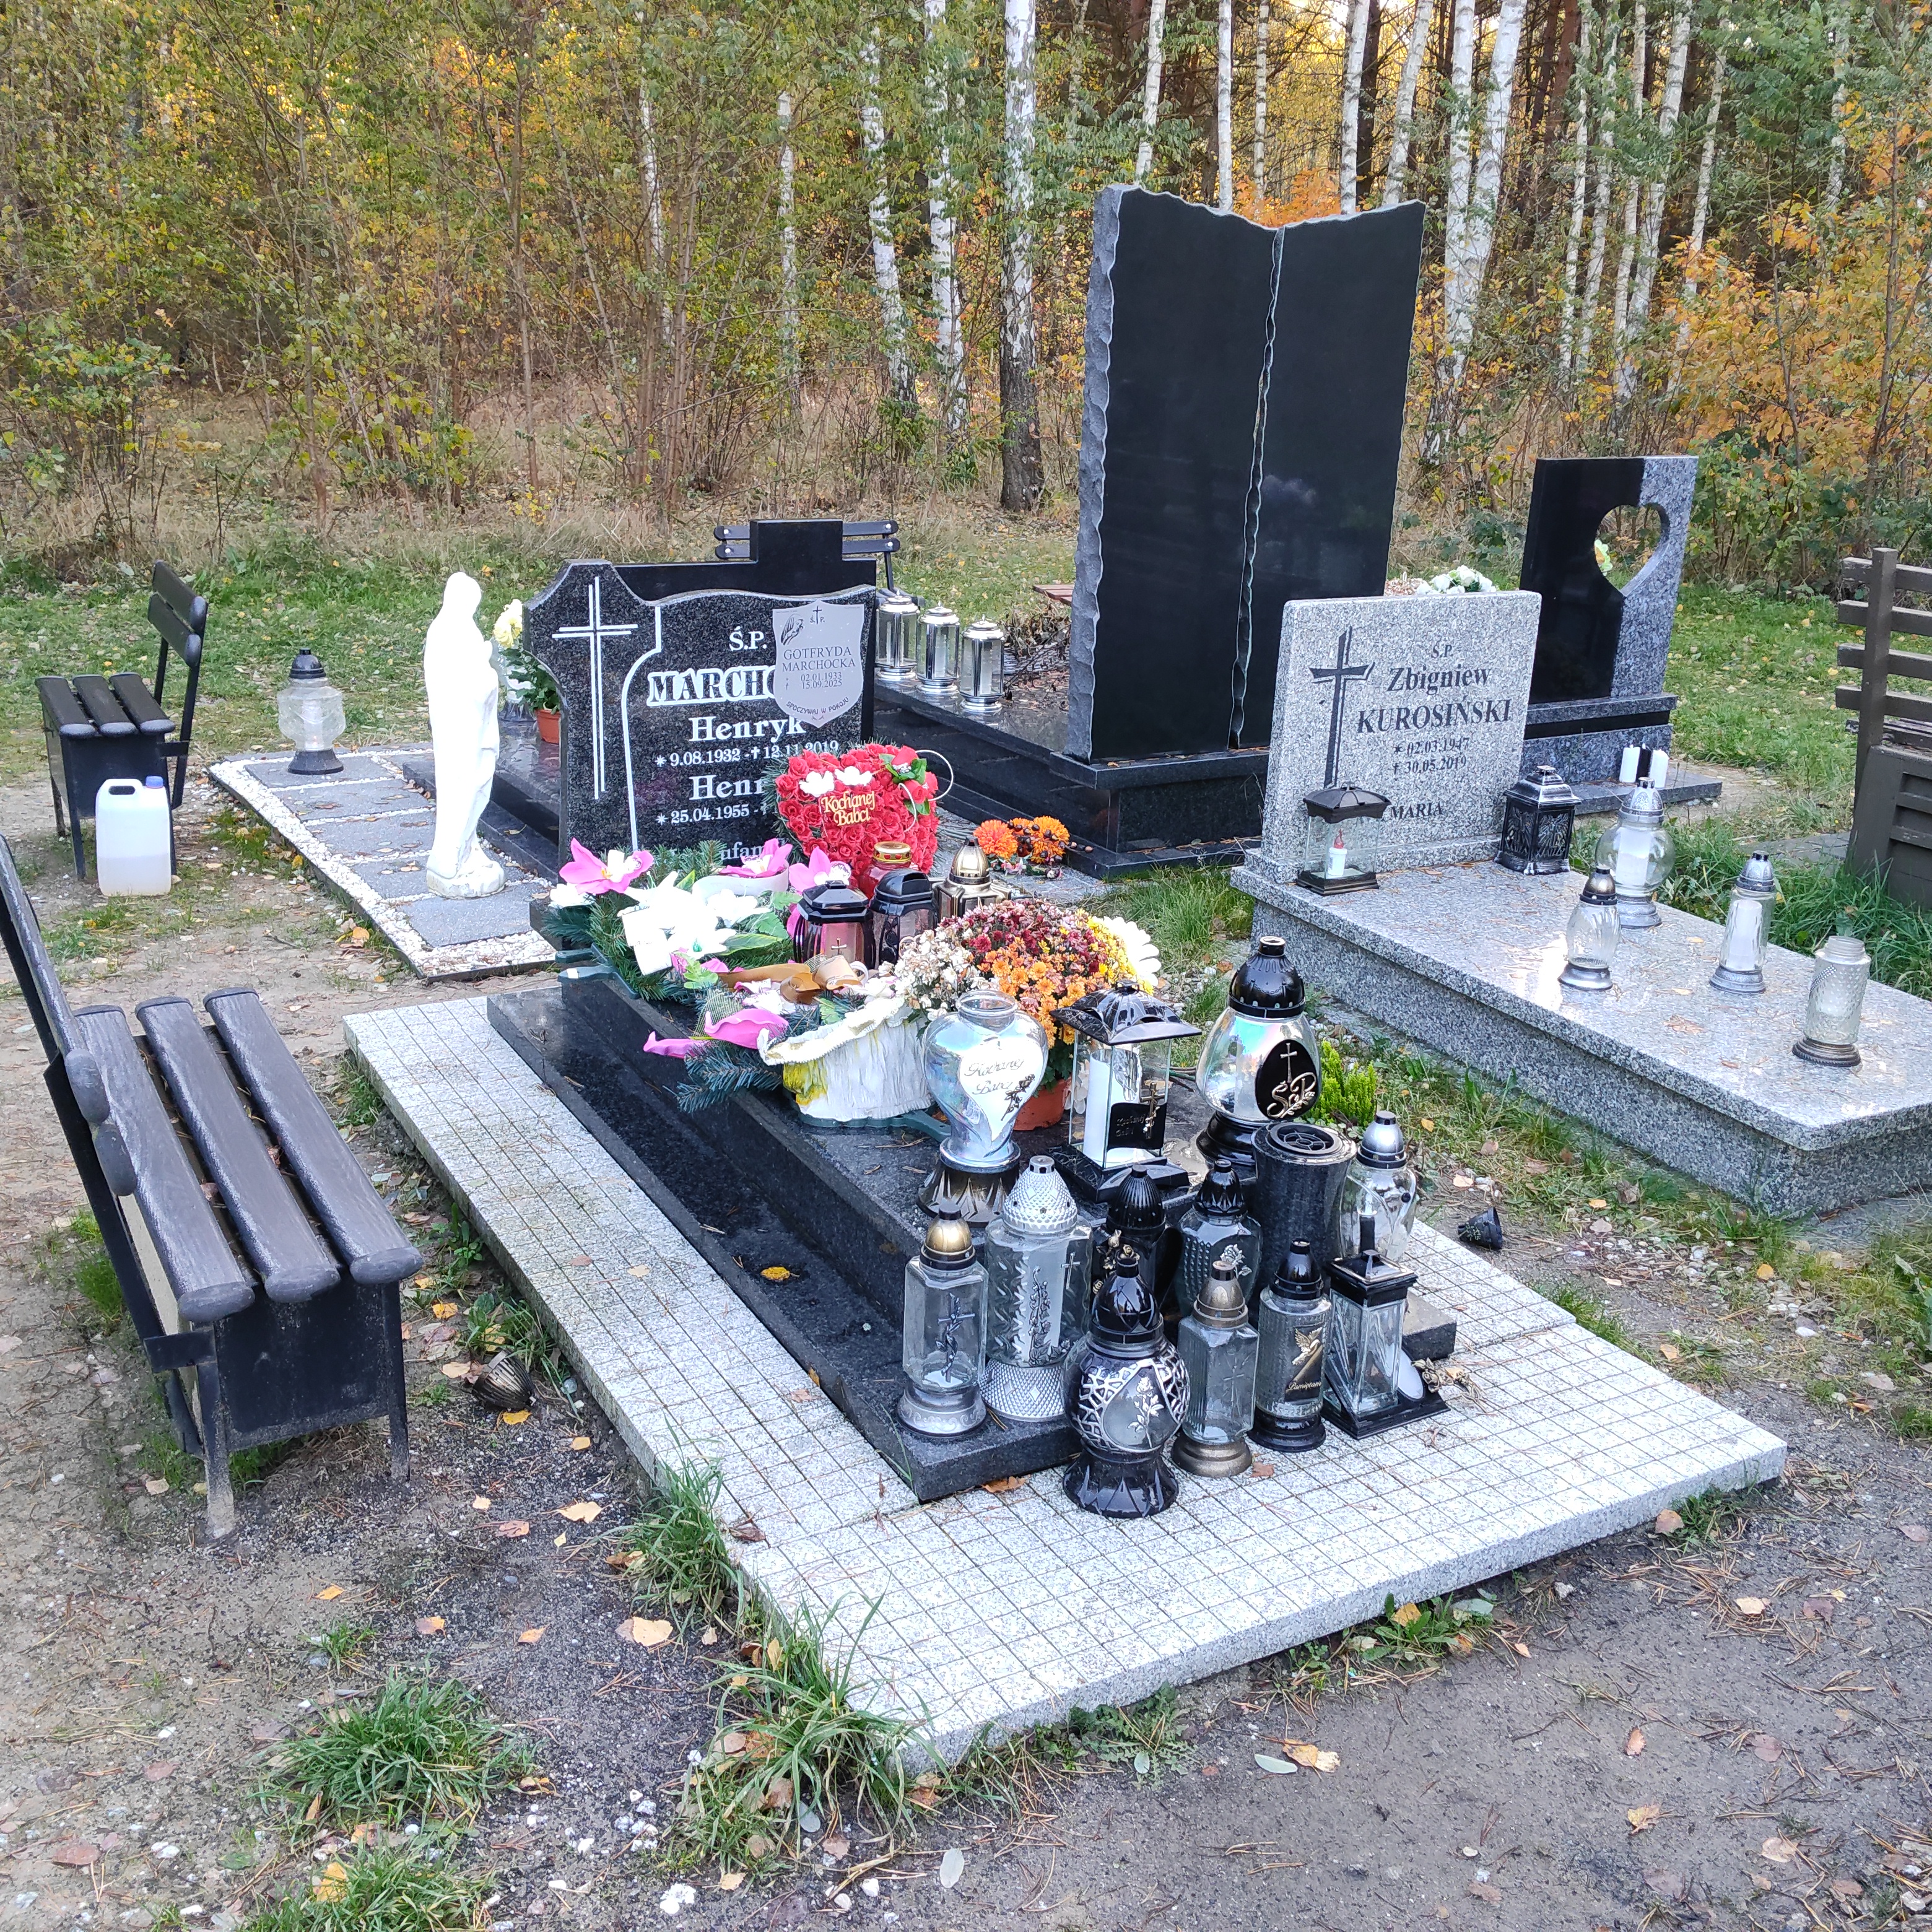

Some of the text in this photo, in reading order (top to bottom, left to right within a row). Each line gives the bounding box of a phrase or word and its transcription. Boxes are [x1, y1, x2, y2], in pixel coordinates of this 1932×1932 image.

[729, 626, 767, 651] Ś.P.
[783, 646, 852, 660] GOTFRYDA
[782, 658, 856, 672] MARCHOCKA
[801, 672, 842, 682] 02.01.1933
[802, 679, 842, 689] 15.09.2025
[1386, 664, 1491, 695] Zbigniew
[786, 700, 819, 715] SPOCZYWAJ
[829, 697, 849, 713] POKOJU
[1357, 695, 1511, 733] KUROSIŃSKI
[689, 715, 806, 742] Henryk
[670, 748, 741, 767] 9.08.1932
[689, 774, 766, 801] Henr
[821, 791, 875, 813] Kochanej
[671, 804, 750, 824] 25.04.1955
[833, 806, 871, 826] Babci
